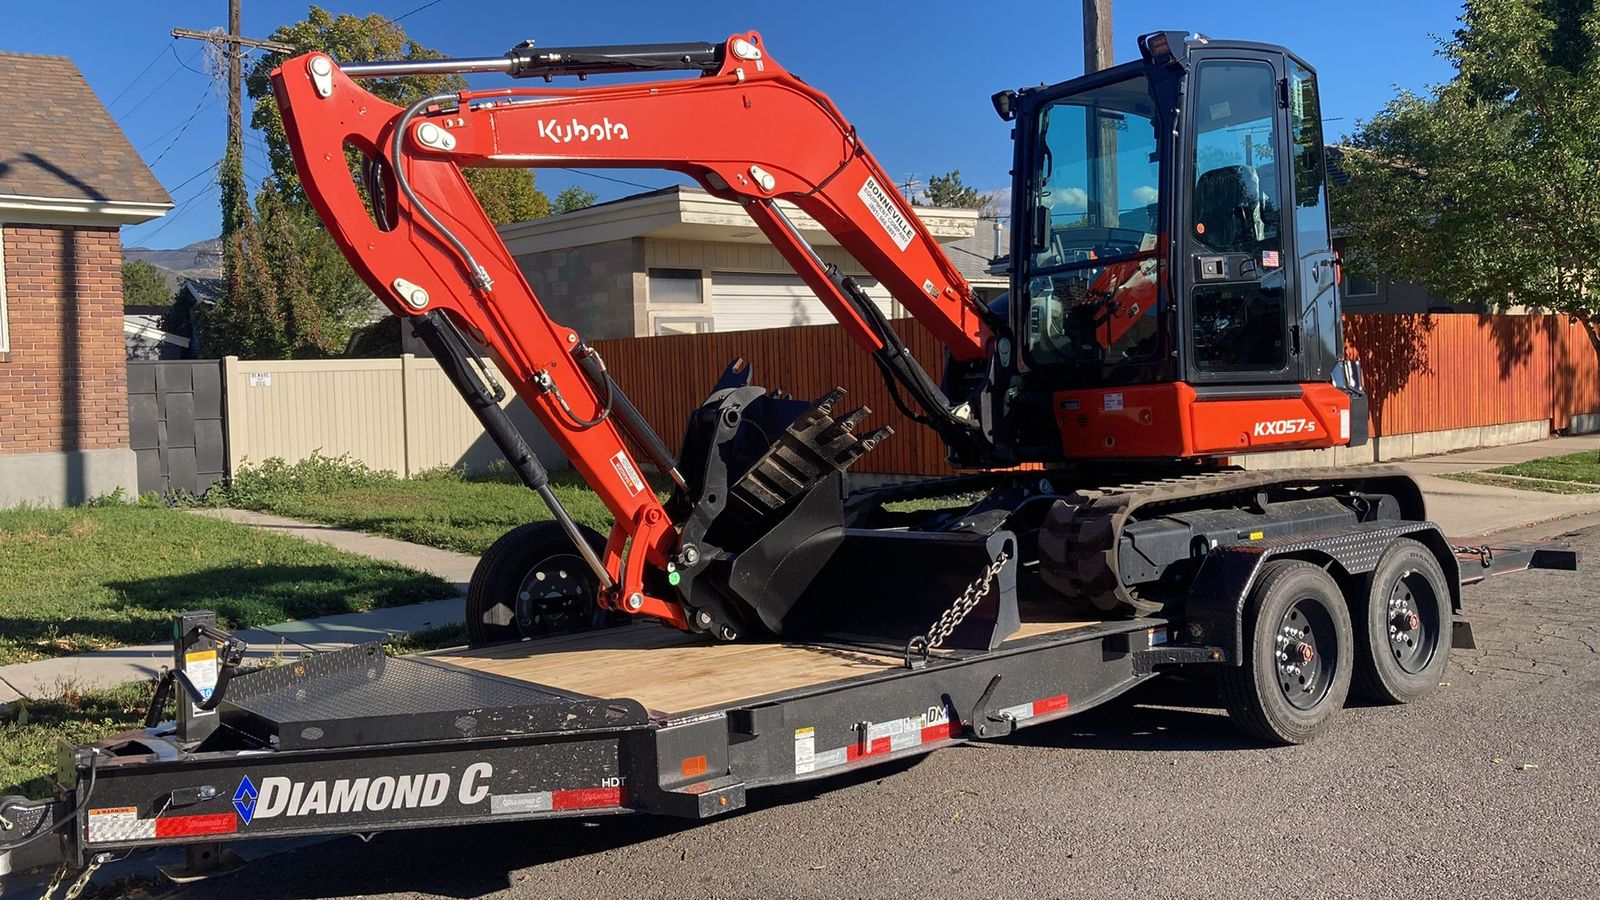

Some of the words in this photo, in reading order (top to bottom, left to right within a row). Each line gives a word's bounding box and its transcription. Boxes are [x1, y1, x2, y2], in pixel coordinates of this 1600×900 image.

[537, 117, 629, 143] Kubota
[863, 186, 889, 218] EQUIPMENT
[887, 217, 909, 243] COMPANY
[866, 179, 914, 240] BONNEVILLE
[253, 773, 451, 818] DIAMOND
[458, 762, 492, 805] C
[601, 776, 627, 788] HDT
